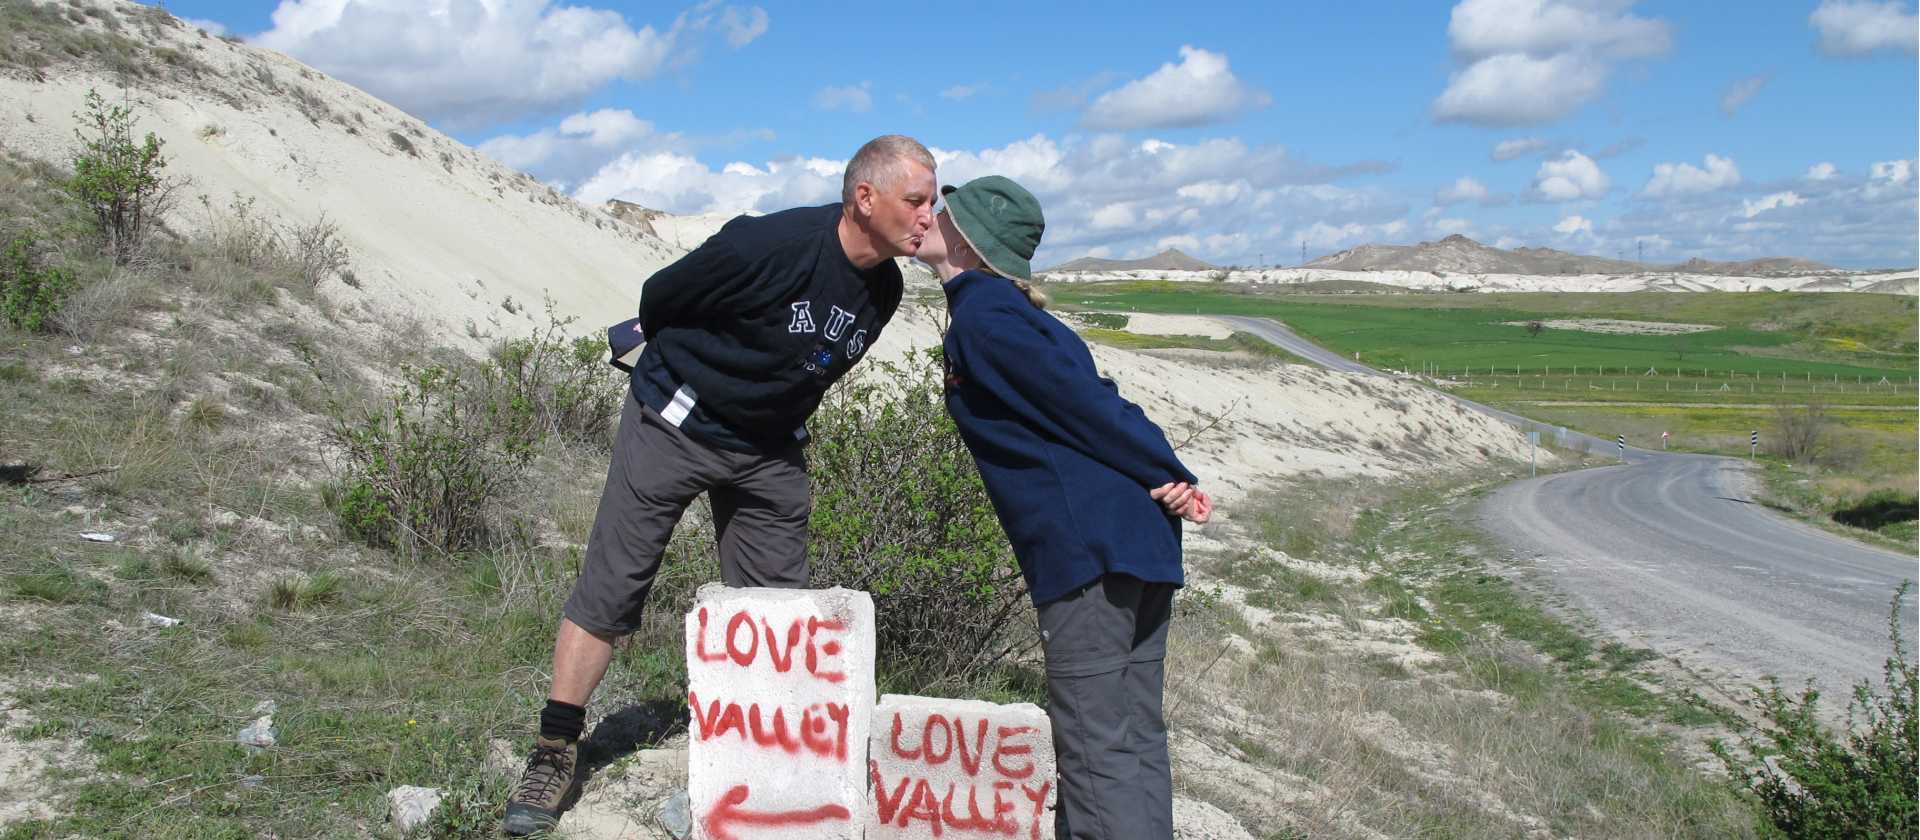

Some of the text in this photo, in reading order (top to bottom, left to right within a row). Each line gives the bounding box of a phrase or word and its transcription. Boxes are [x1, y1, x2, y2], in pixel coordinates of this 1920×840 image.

[788, 301, 867, 359] AUS
[697, 607, 846, 683] LOVE
[688, 691, 849, 762] VALLEY
[891, 712, 1039, 779] LOVE
[869, 759, 1050, 840] VALLEY
